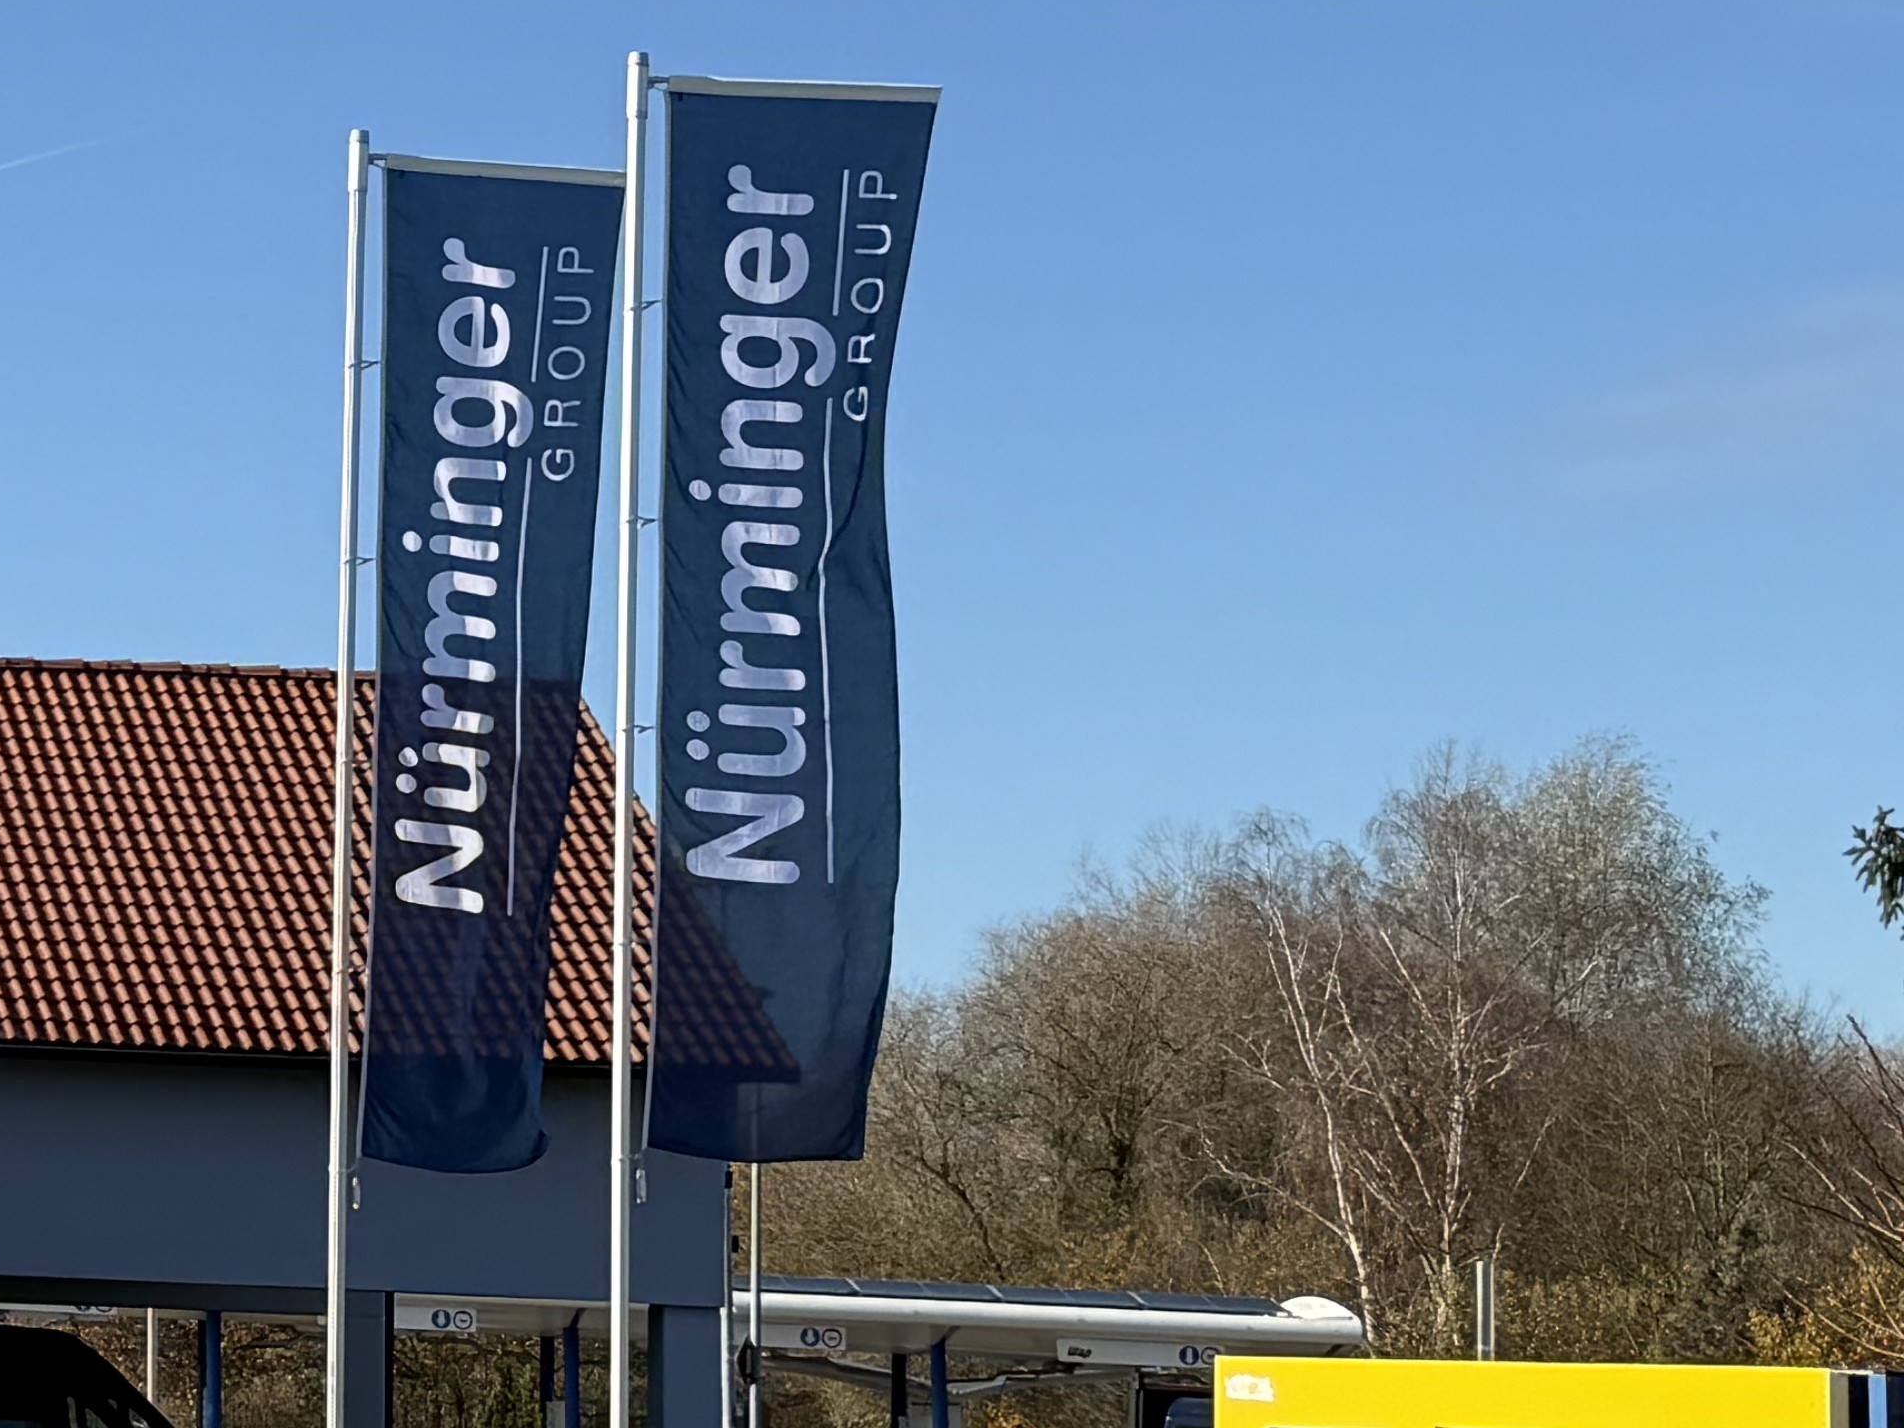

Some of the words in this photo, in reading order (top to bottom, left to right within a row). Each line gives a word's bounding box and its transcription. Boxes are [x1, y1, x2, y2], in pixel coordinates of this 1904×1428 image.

[542, 246, 596, 483] GROUP
[685, 164, 838, 885] Nürminger
[842, 169, 900, 422] GROUP
[394, 236, 534, 915] Nürminger
